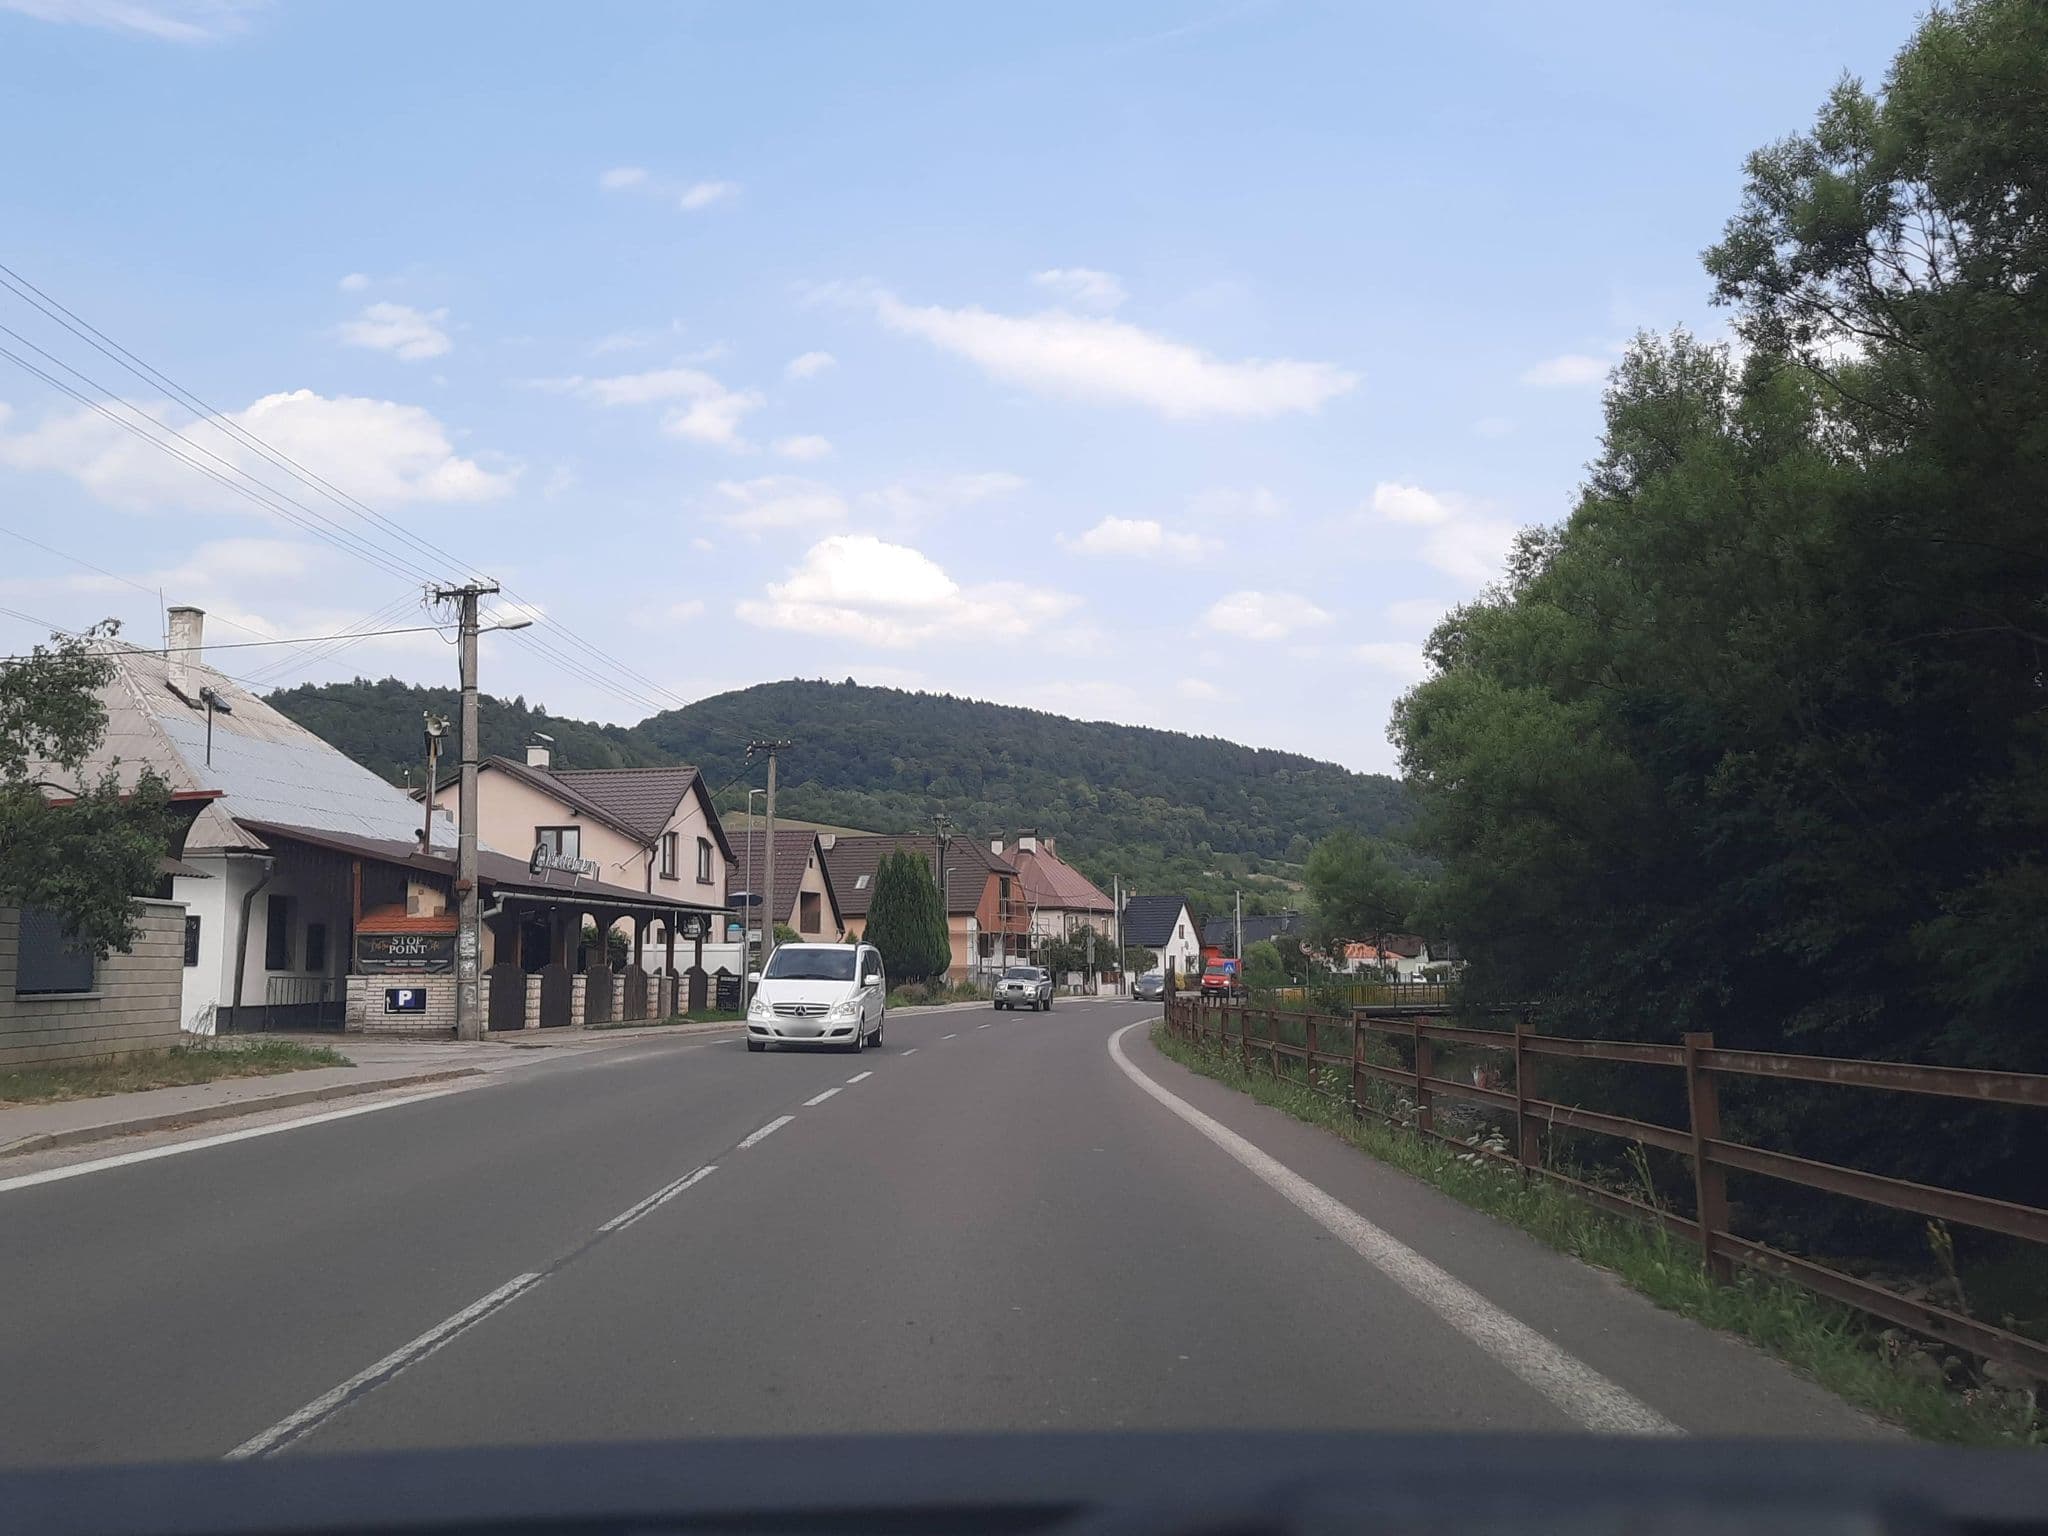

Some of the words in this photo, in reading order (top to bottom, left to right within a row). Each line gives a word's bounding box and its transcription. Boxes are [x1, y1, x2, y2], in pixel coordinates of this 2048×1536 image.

[392, 936, 423, 945] STOP
[388, 945, 427, 954] POINT
[398, 990, 413, 1006] P
